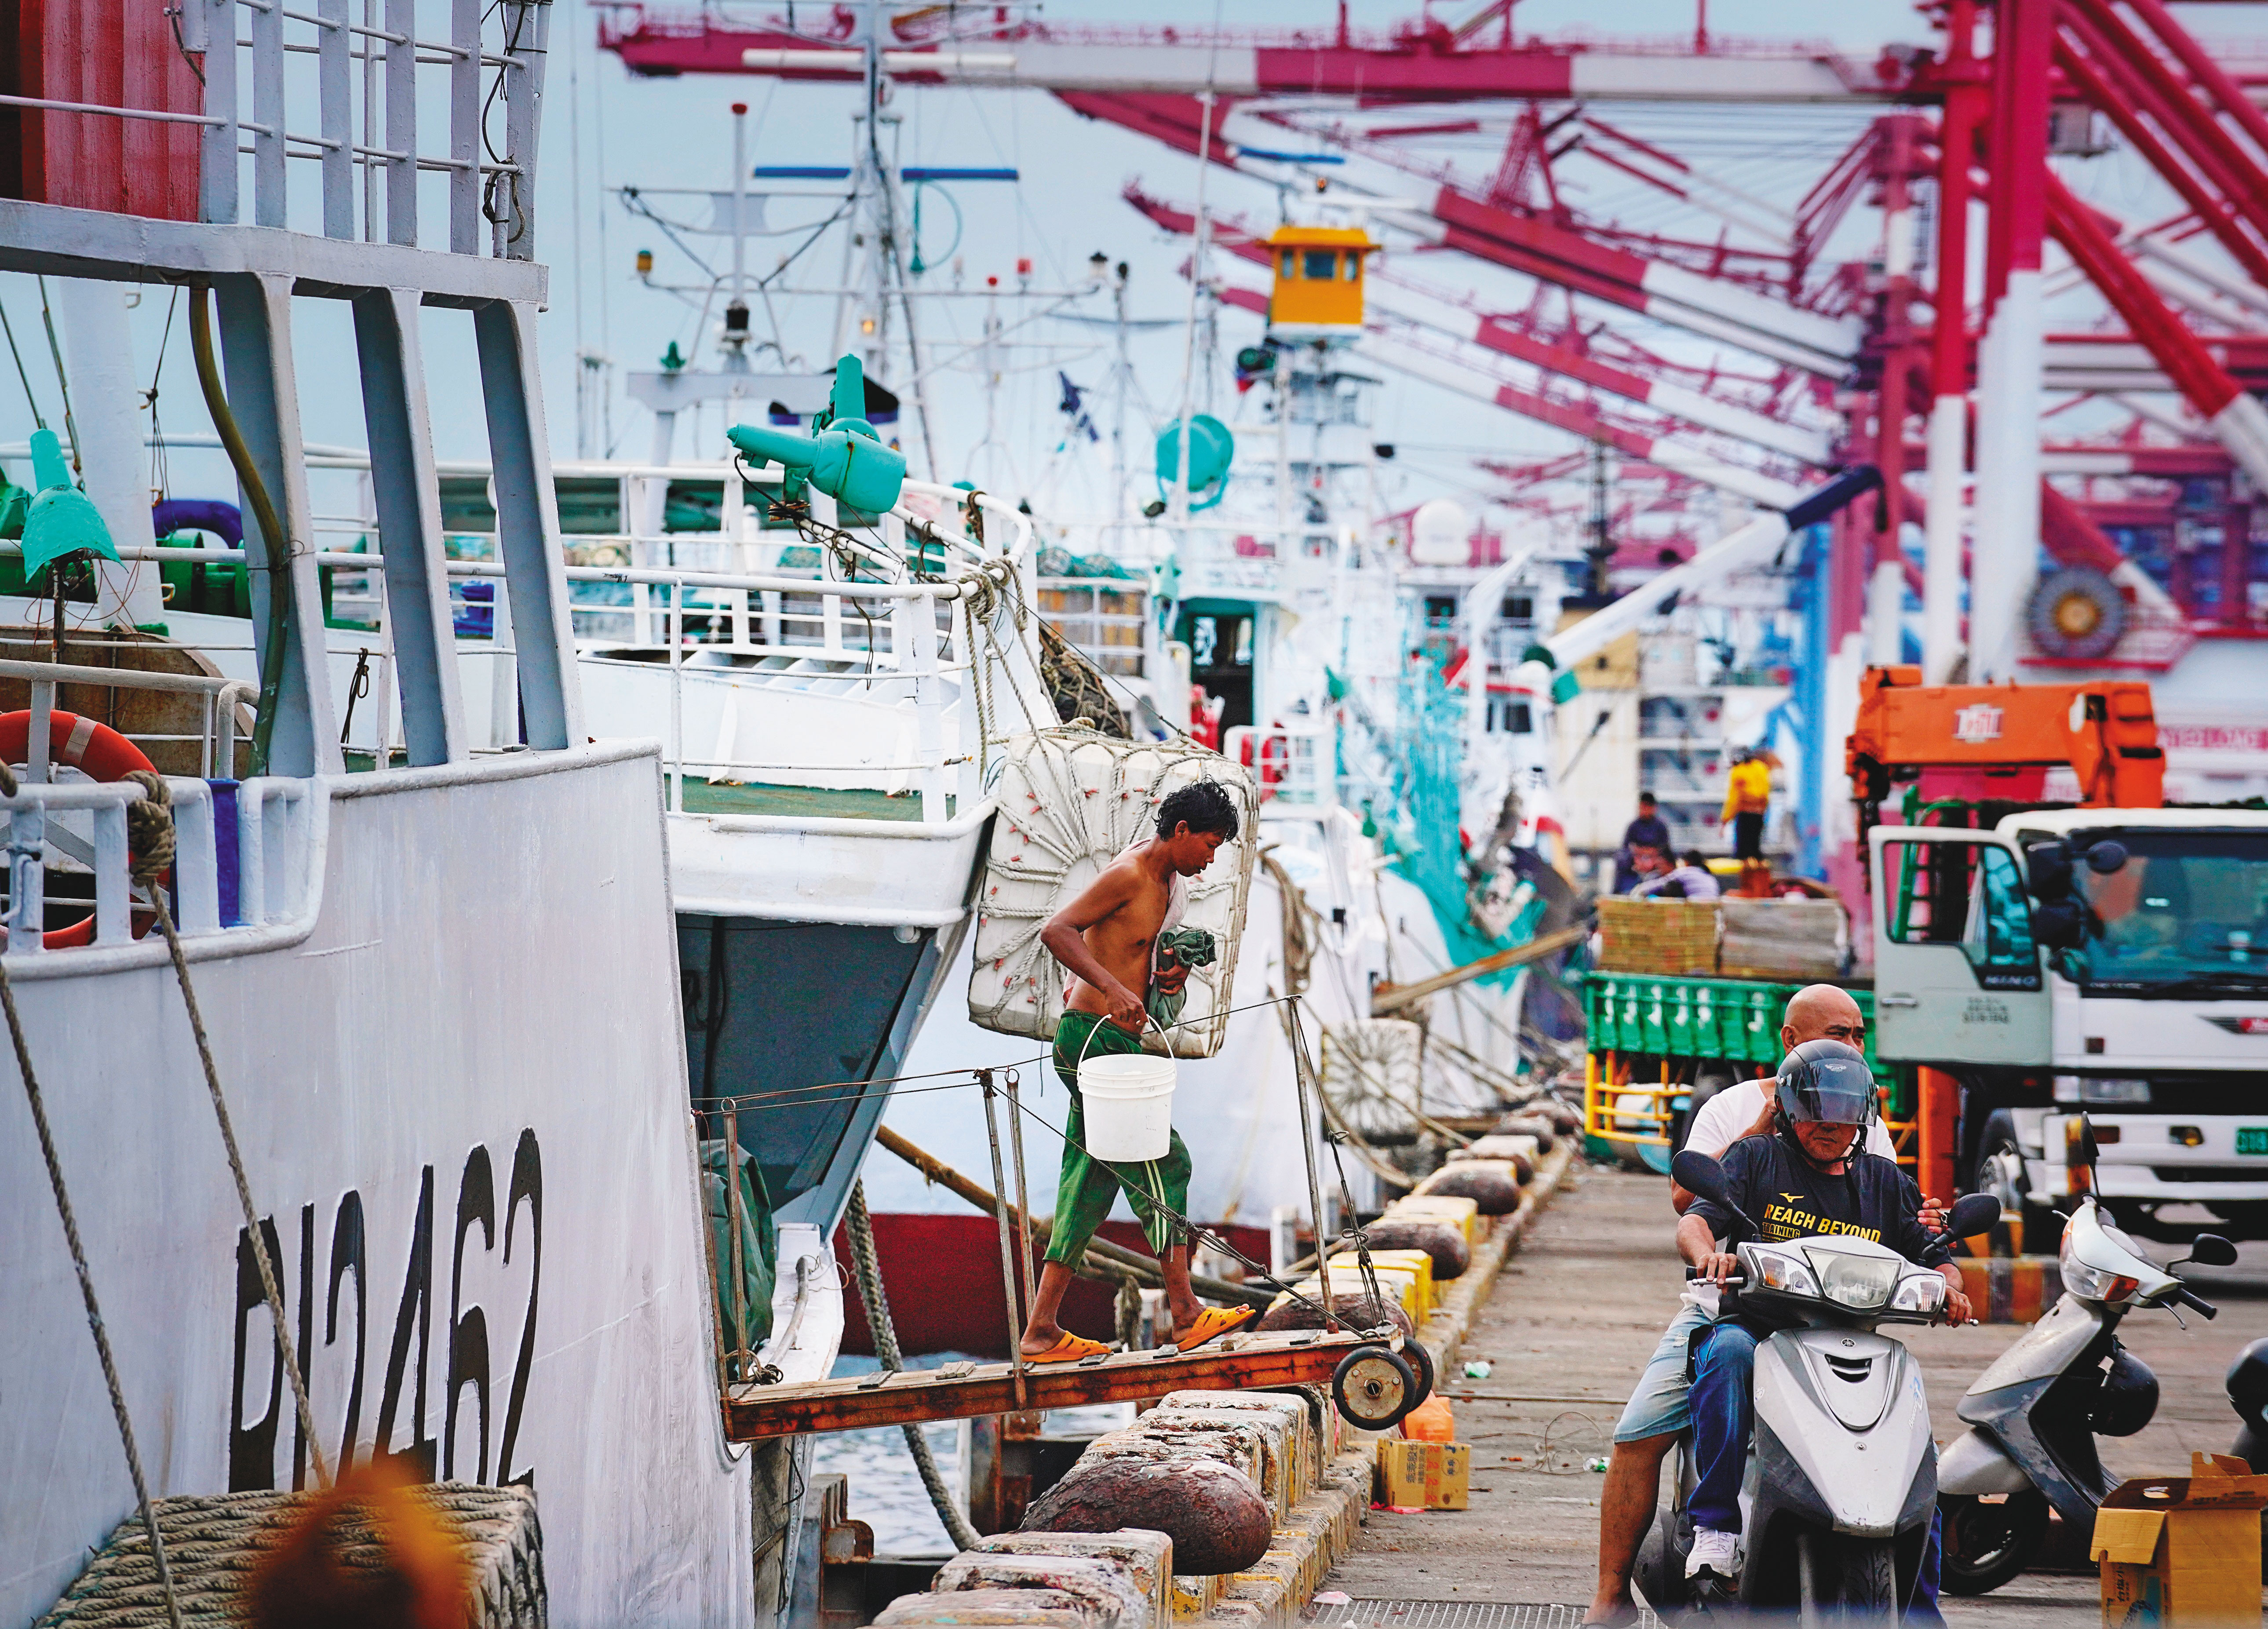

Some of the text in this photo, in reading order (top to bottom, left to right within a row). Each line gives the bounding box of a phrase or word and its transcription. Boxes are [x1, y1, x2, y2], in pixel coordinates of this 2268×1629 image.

[1762, 1222, 1801, 1239] TRAINING
[1764, 1204, 1881, 1243] REACH BEYOND
